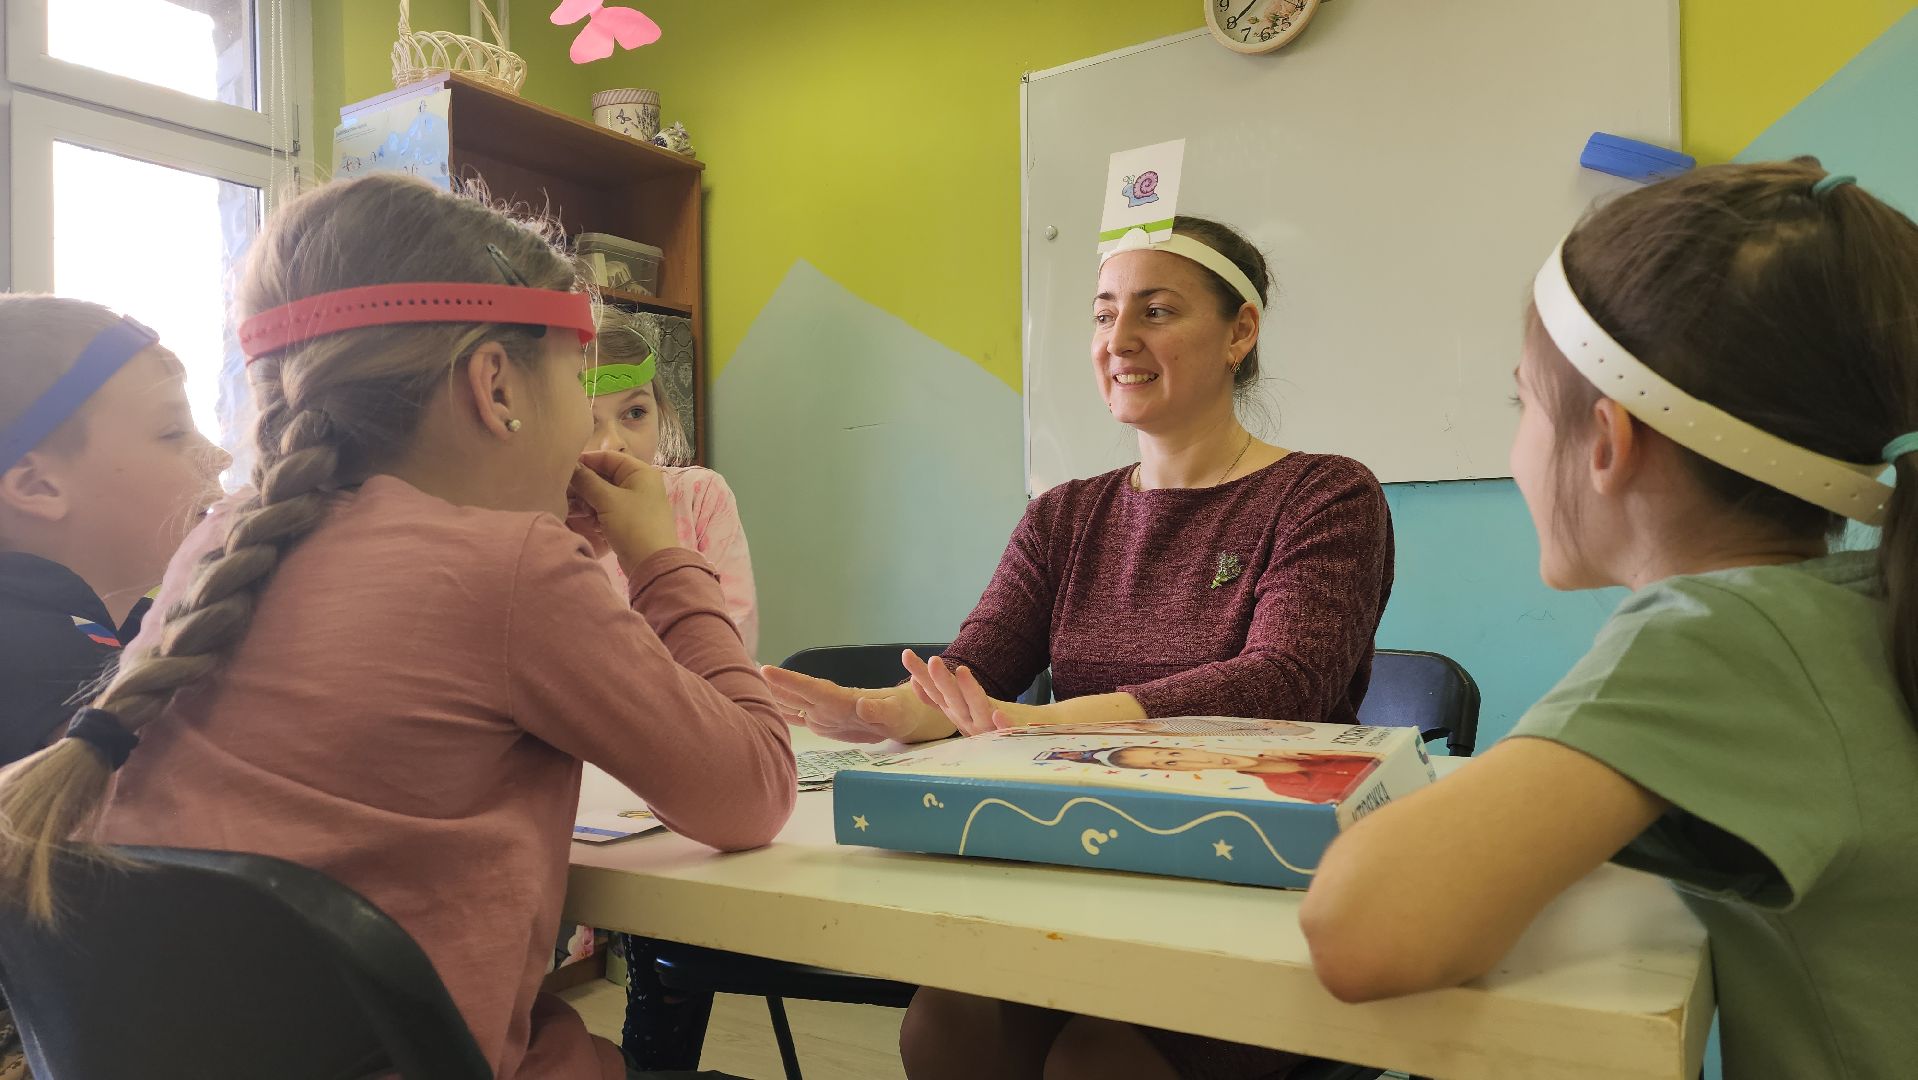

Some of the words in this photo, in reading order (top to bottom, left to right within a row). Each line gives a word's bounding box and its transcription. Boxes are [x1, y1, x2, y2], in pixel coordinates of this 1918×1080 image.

[1226, 15, 1238, 30] 8
[1240, 26, 1252, 42] 7
[1260, 26, 1271, 41] 6
